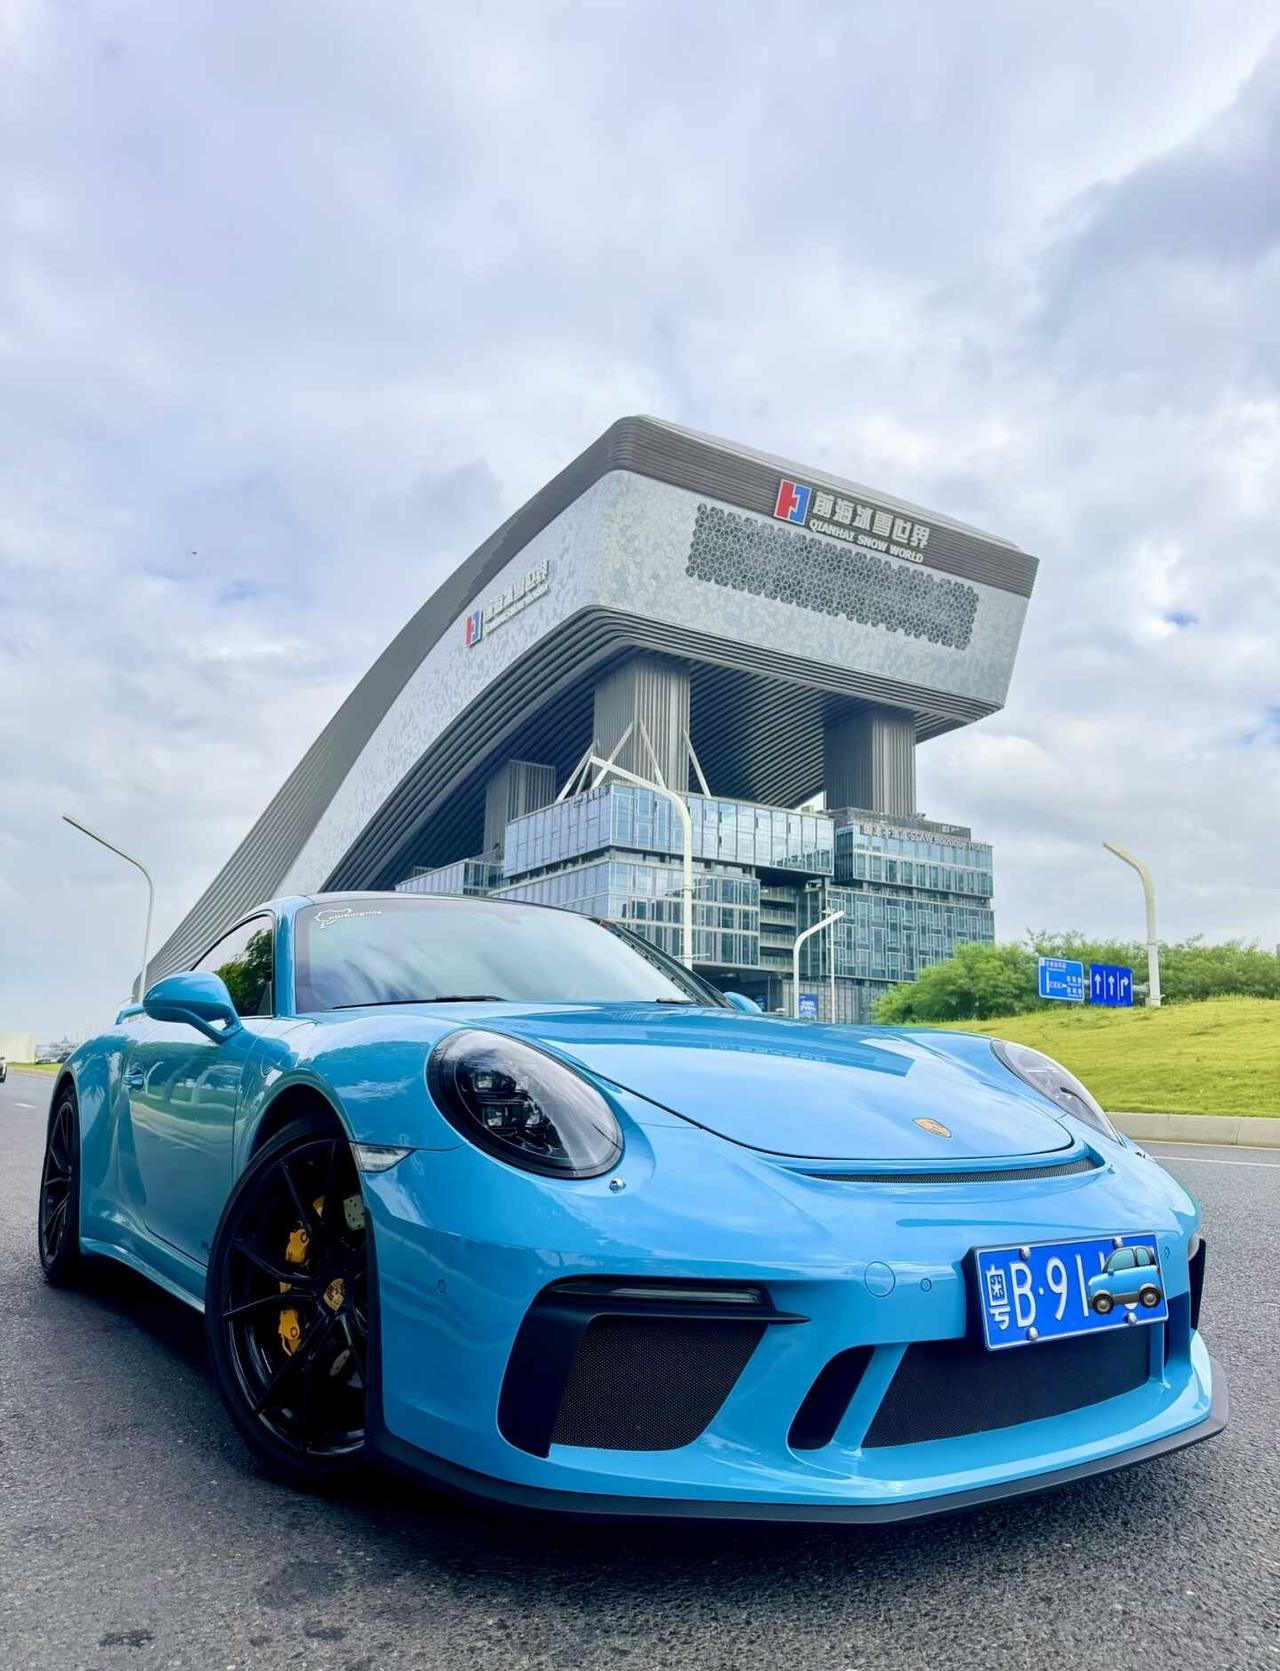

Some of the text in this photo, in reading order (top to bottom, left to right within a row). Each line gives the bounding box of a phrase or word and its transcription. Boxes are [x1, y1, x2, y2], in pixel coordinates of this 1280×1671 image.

[809, 519, 924, 563] QIANHAI SNOW WORLD
[813, 491, 930, 548] 前海冰雪世界
